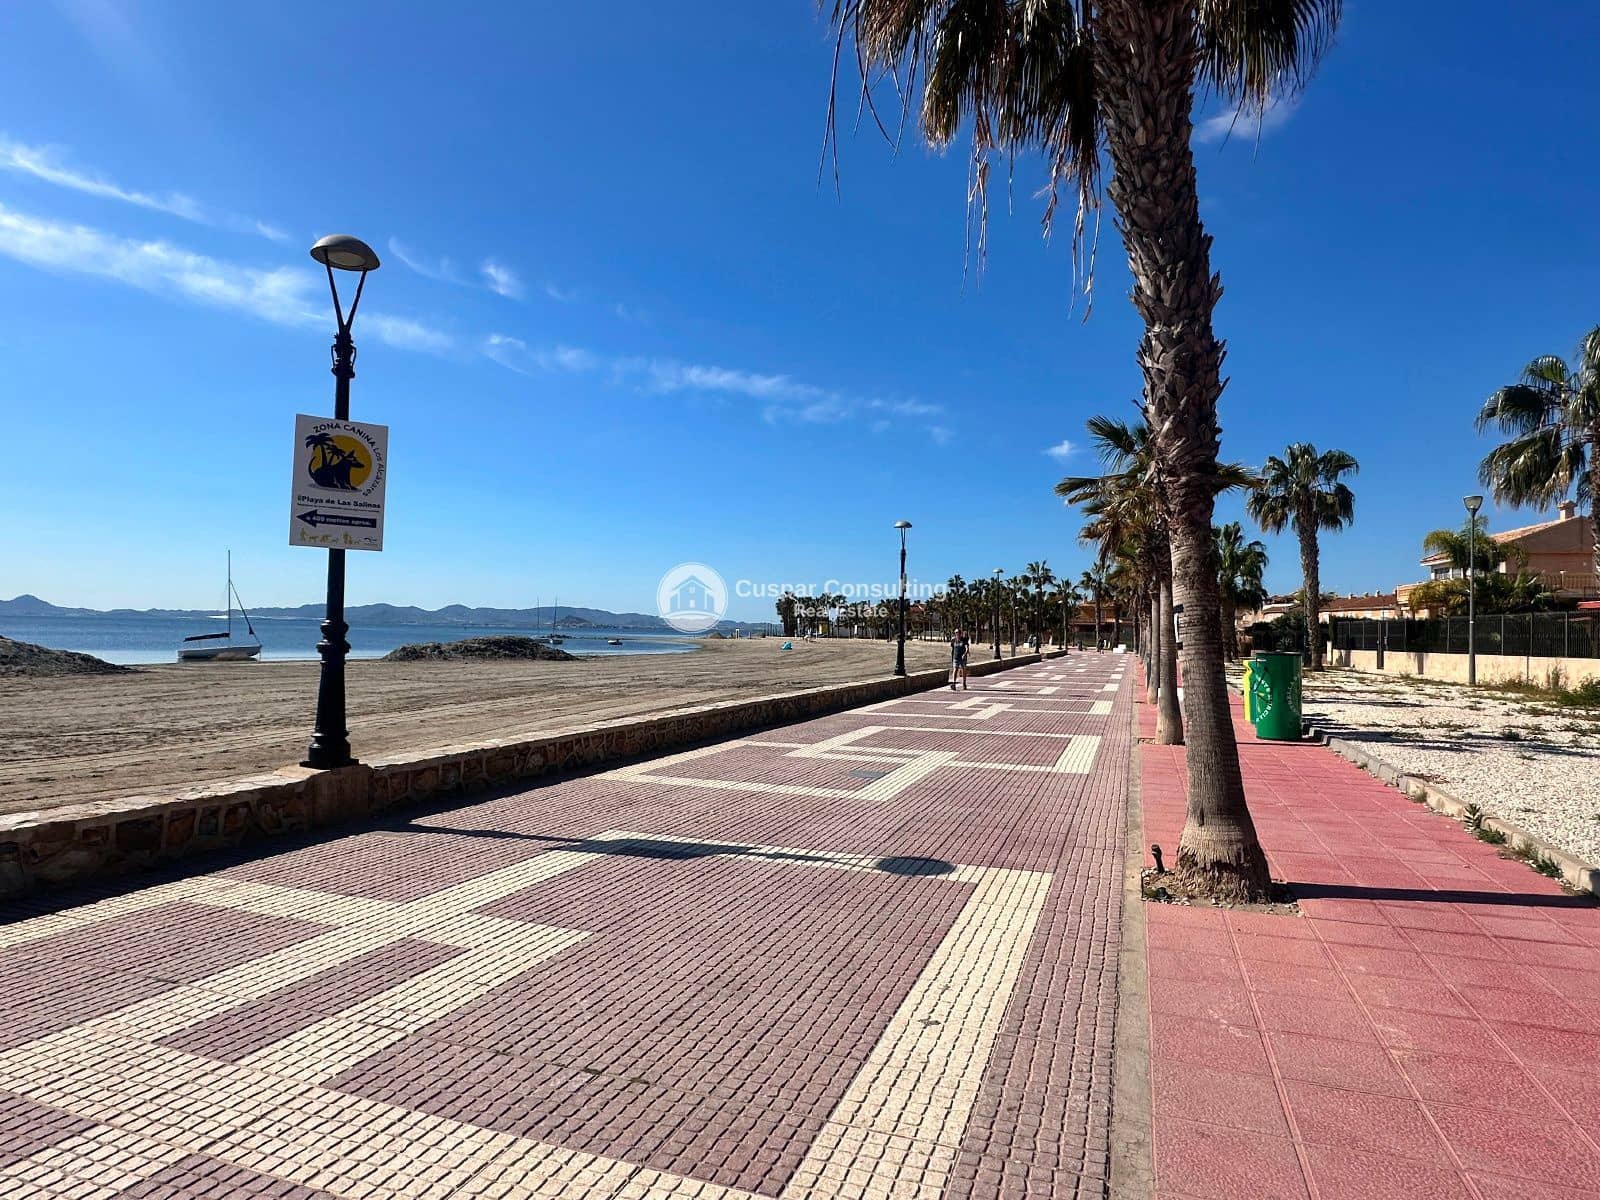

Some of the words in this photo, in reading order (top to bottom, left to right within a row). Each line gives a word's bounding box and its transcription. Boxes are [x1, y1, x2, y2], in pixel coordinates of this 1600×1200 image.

[313, 422, 341, 433] ZONA
[343, 424, 376, 447] CANINA
[301, 495, 324, 504] Playa
[325, 497, 336, 505] de
[353, 500, 381, 509] Salinas
